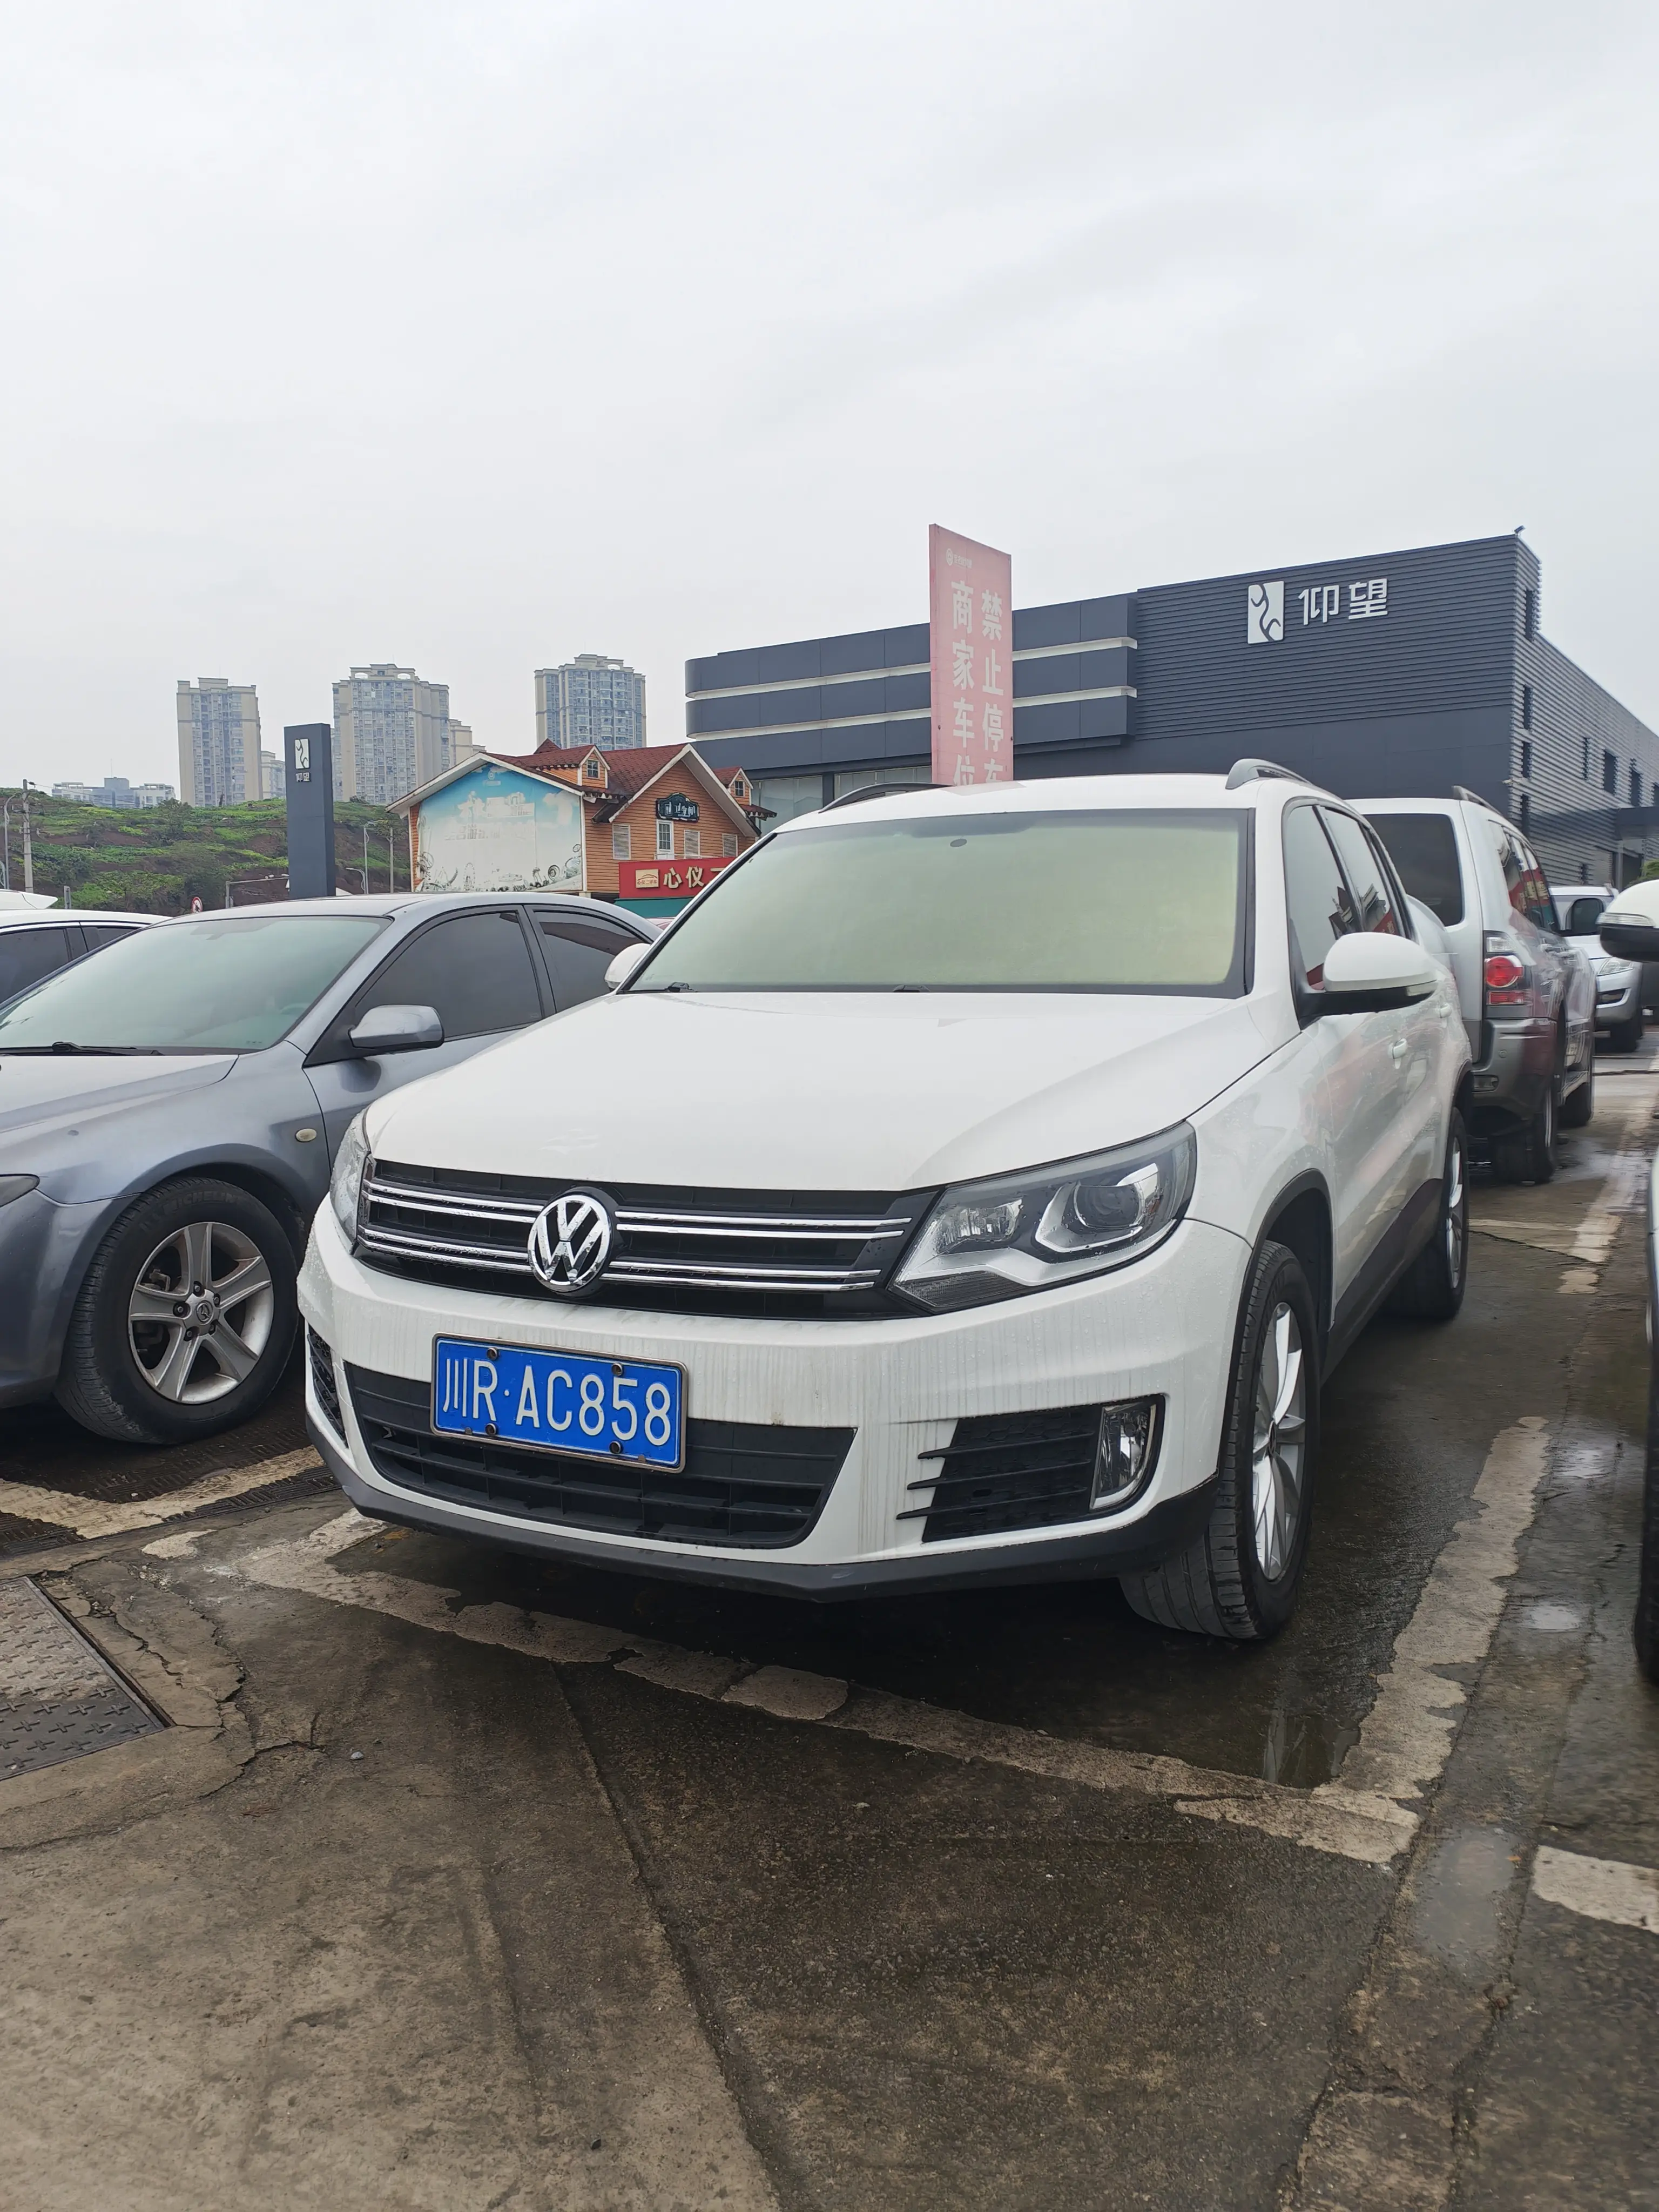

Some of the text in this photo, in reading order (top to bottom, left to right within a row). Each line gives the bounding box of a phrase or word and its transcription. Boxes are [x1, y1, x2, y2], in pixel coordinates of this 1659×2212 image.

[1298, 578, 1388, 625] 仰望
[951, 580, 975, 786] 商家车位
[295, 772, 310, 782] 仰望
